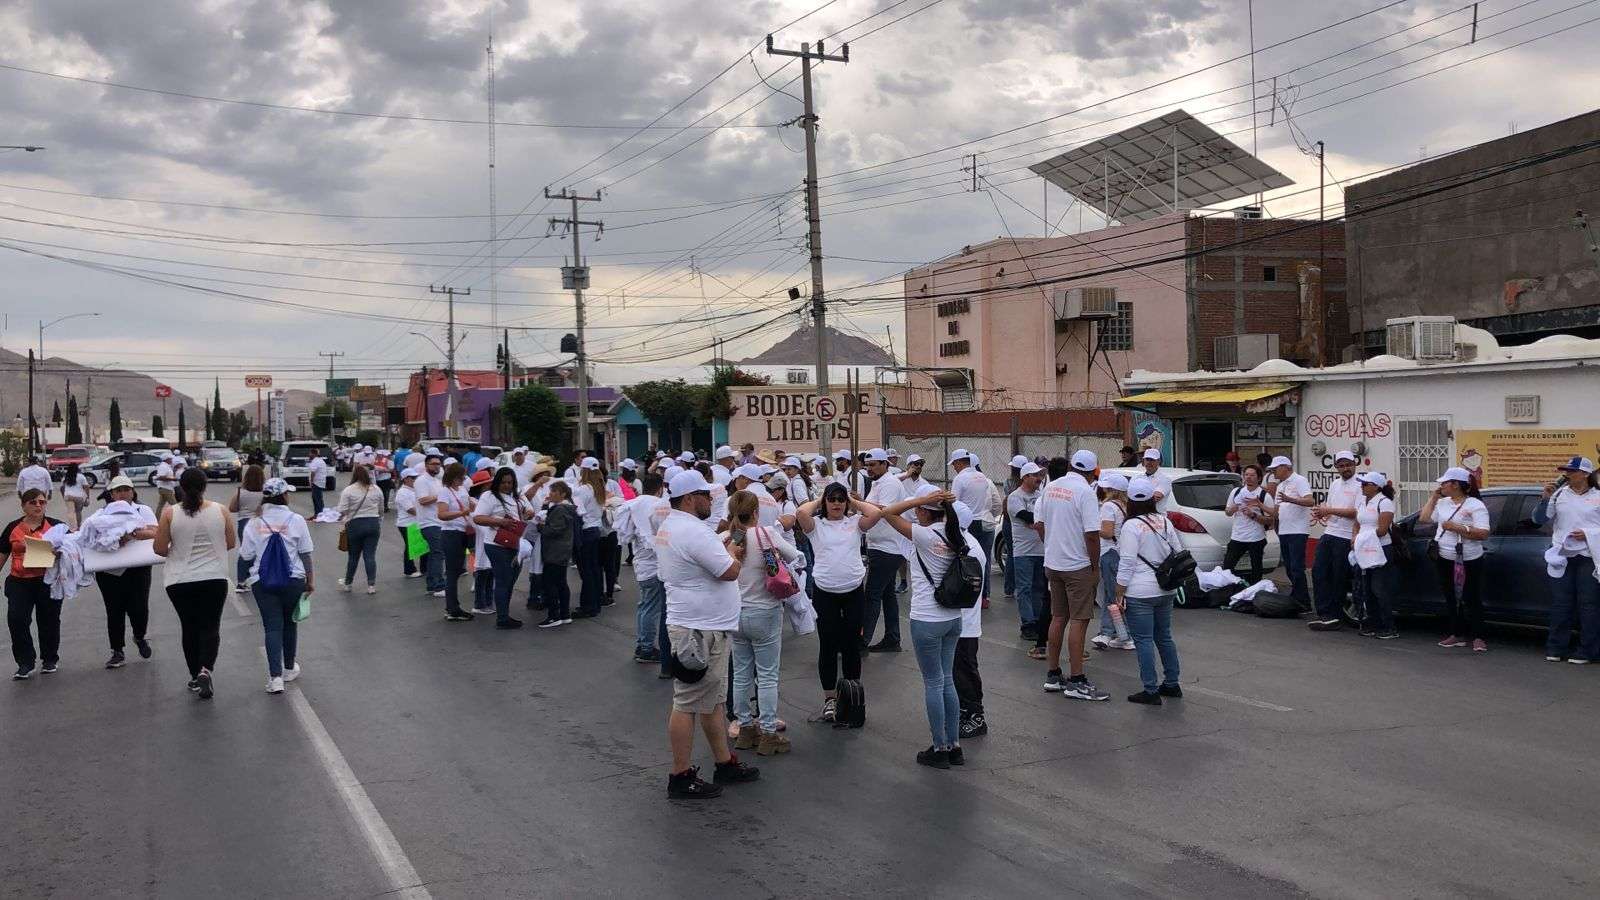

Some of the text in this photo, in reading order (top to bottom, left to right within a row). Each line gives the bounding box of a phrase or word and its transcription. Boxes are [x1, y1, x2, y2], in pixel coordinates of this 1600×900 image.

[746, 394, 816, 417] BODEG
[766, 418, 851, 440] LIBRS
[1305, 413, 1391, 438] COPIAS
